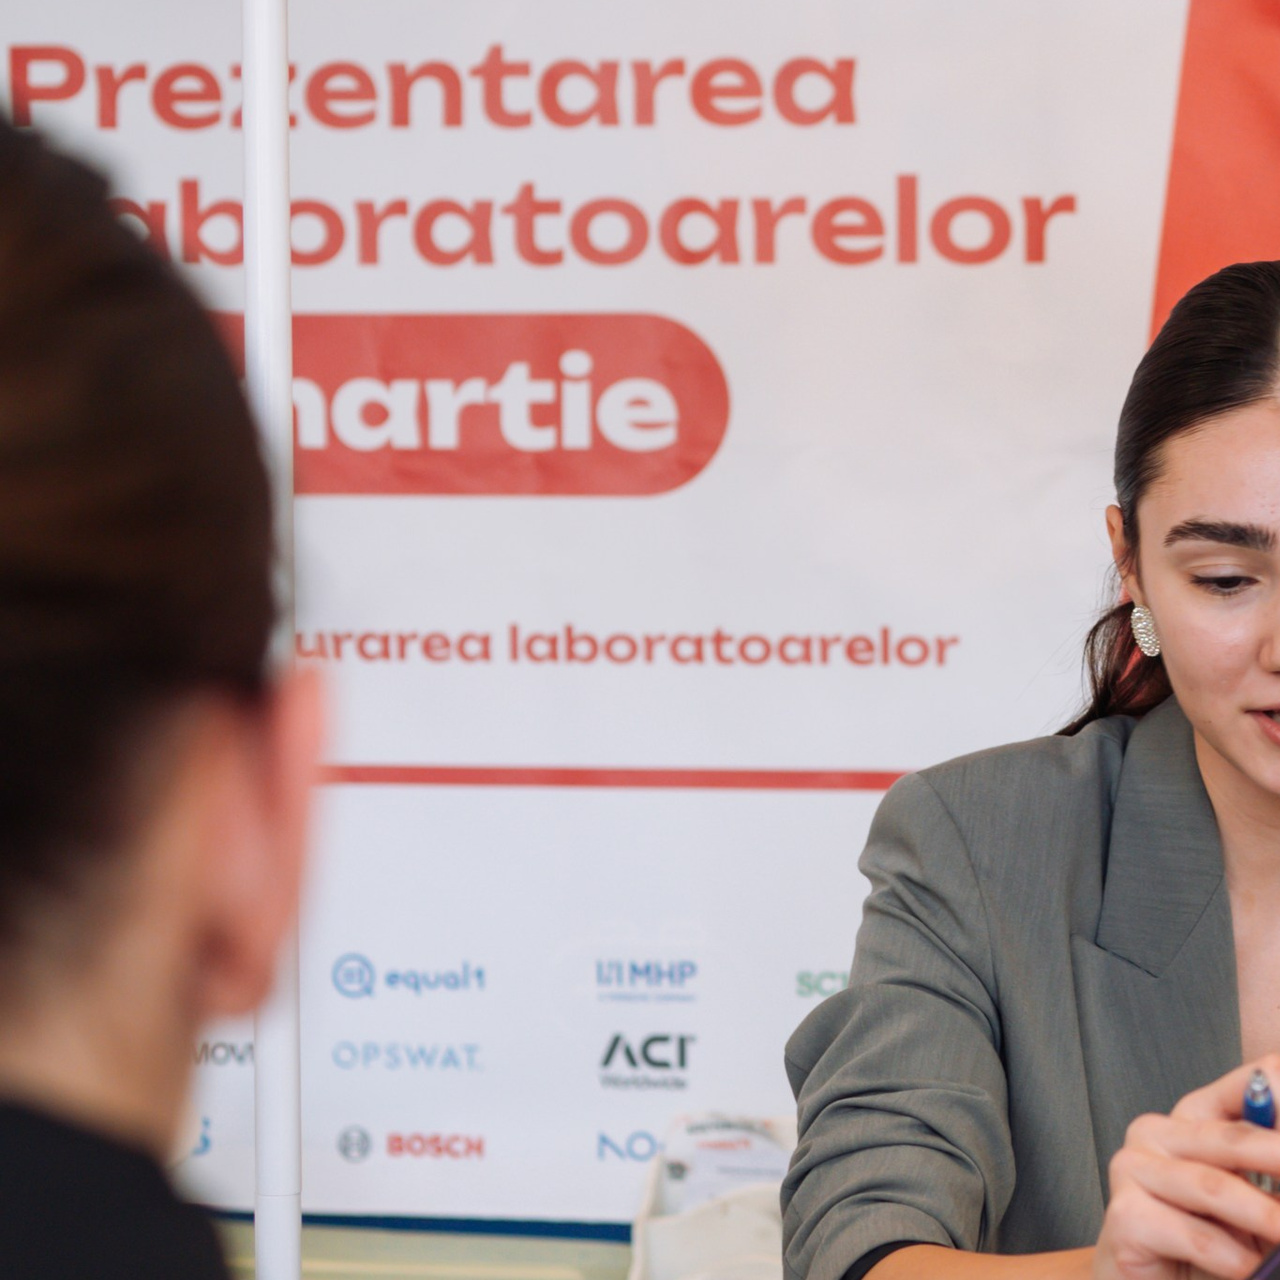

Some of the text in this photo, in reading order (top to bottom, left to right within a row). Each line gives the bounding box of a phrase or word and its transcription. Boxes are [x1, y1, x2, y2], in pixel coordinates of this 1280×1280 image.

[107, 174, 1076, 268] aboratoarelor
[294, 624, 961, 667] urarea laboratoarelor
[385, 1133, 485, 1158] BOSCH
